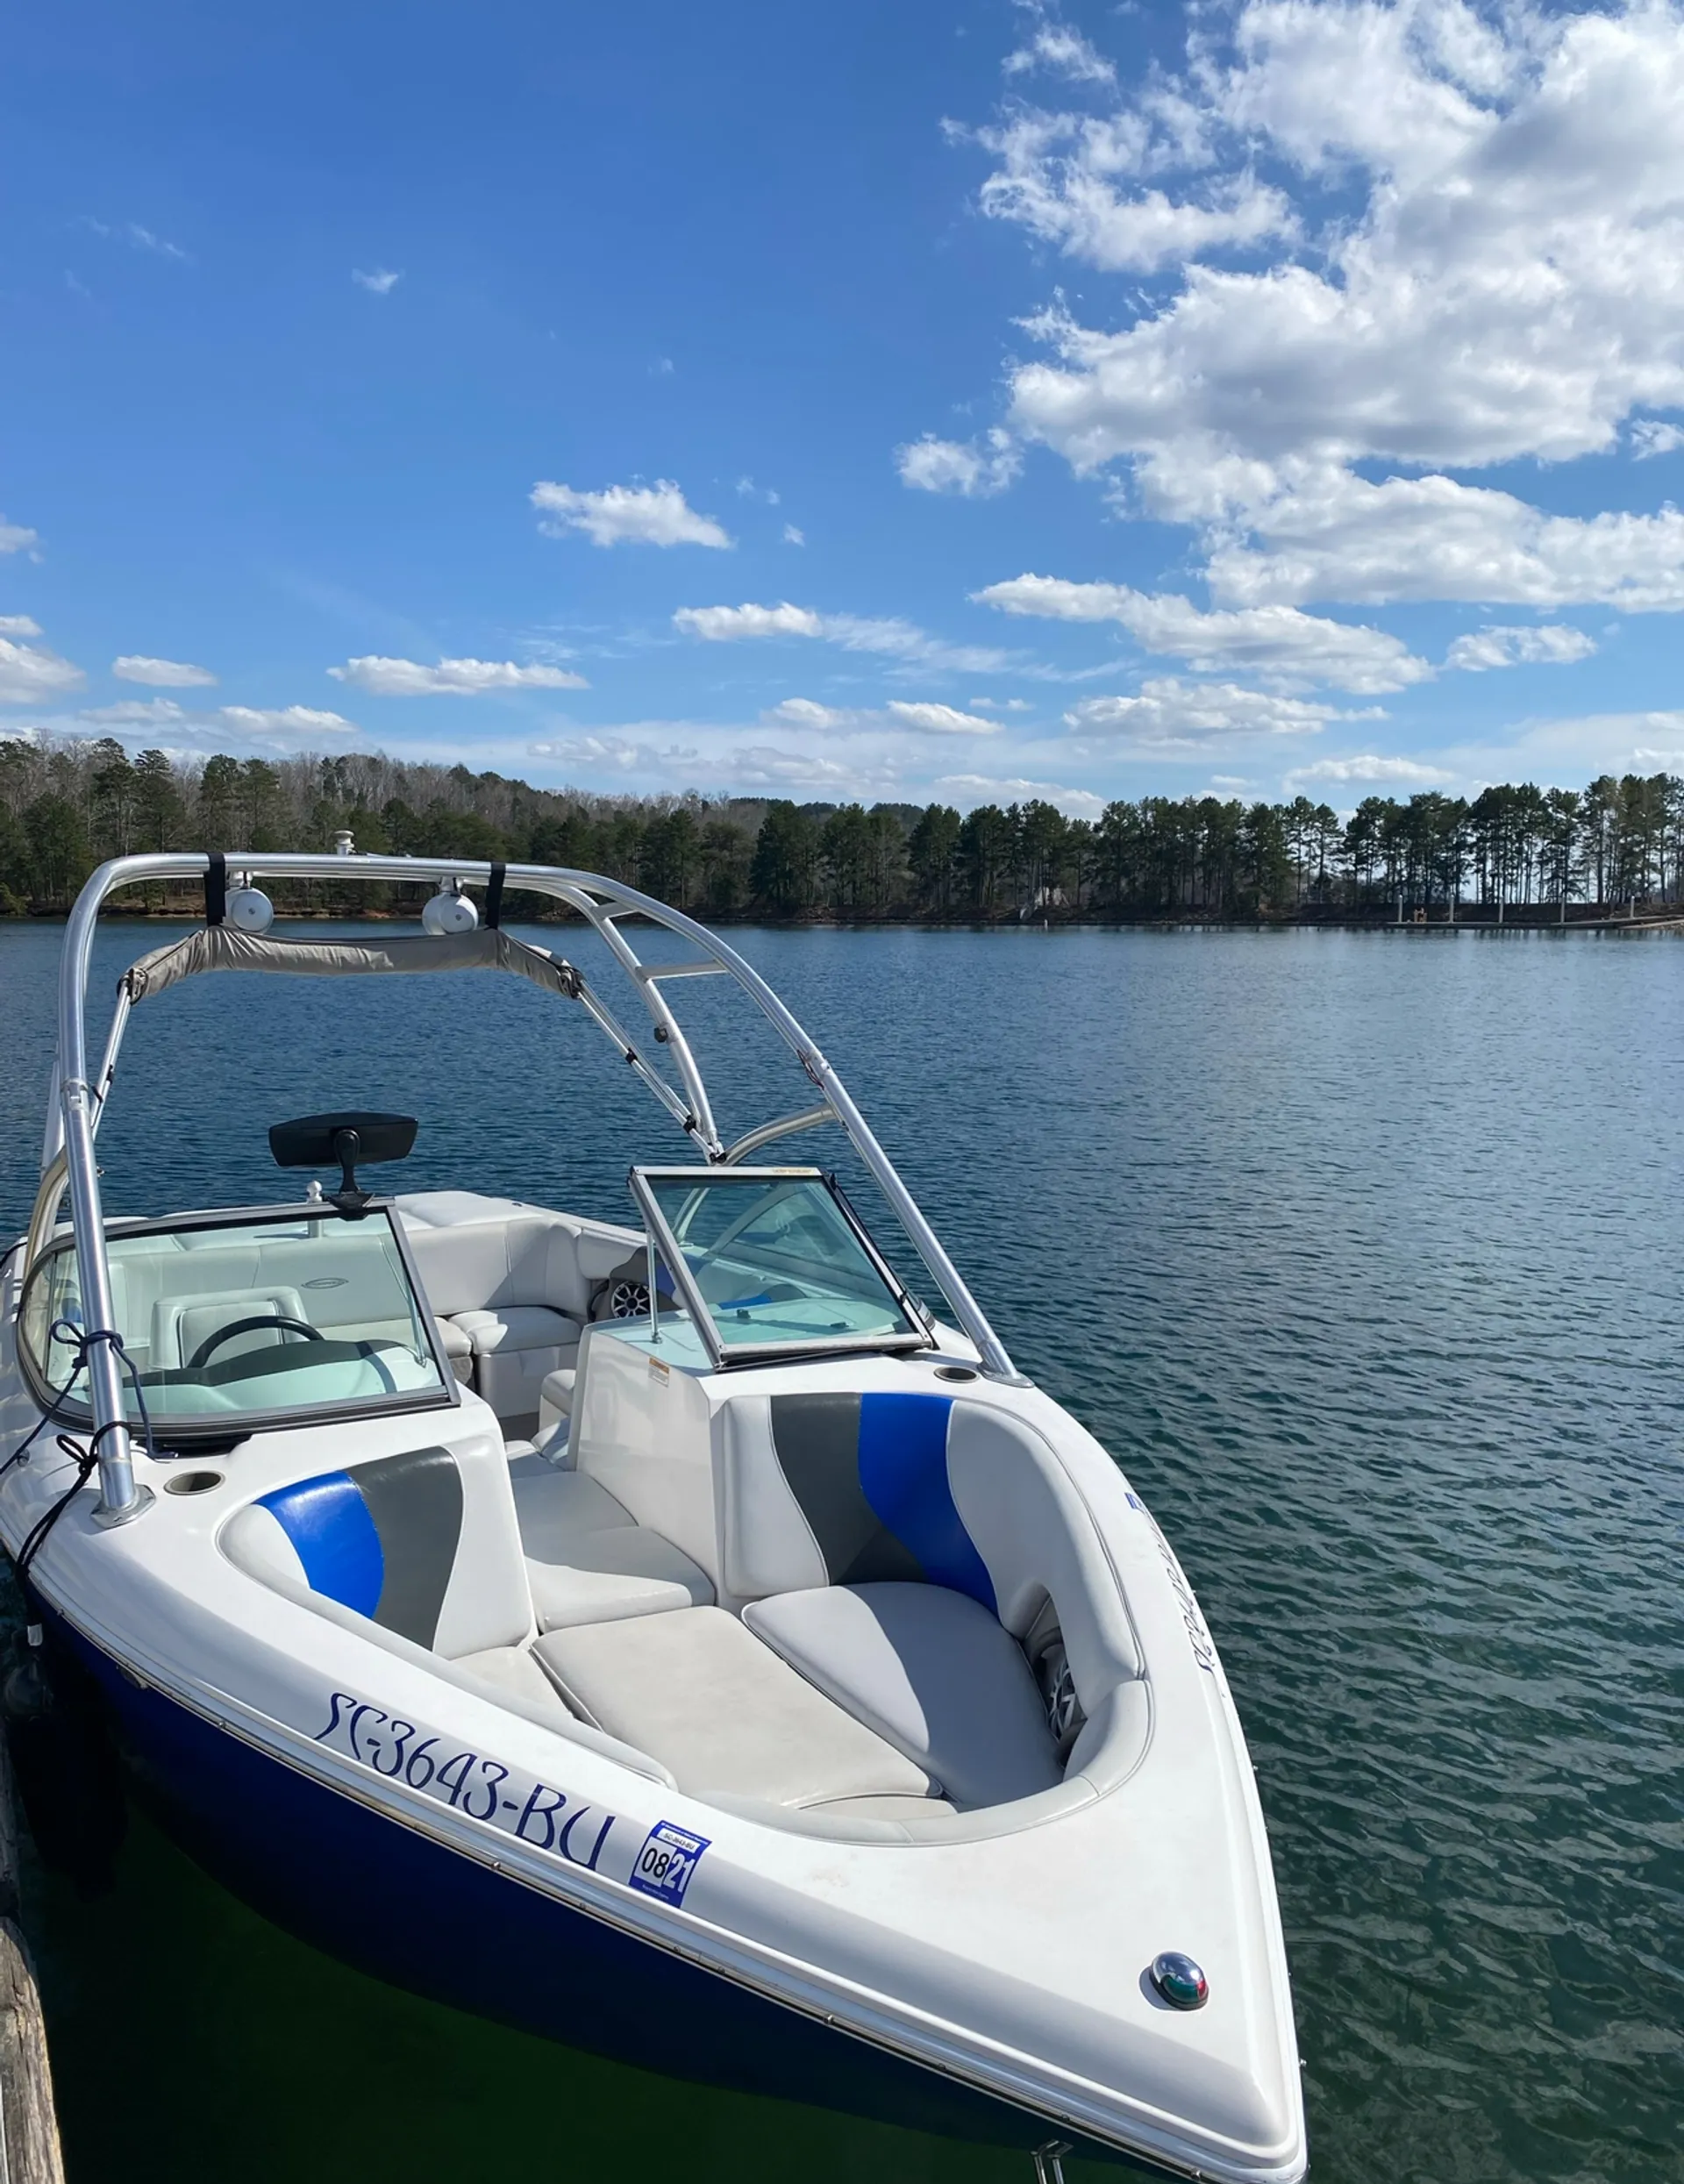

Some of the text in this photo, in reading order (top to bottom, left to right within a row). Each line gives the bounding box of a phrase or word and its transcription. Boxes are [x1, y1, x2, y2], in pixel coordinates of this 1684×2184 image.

[312, 1692, 617, 1871] SC-3643-BU
[641, 1847, 670, 1878] 08
[663, 1852, 696, 1893] 21
